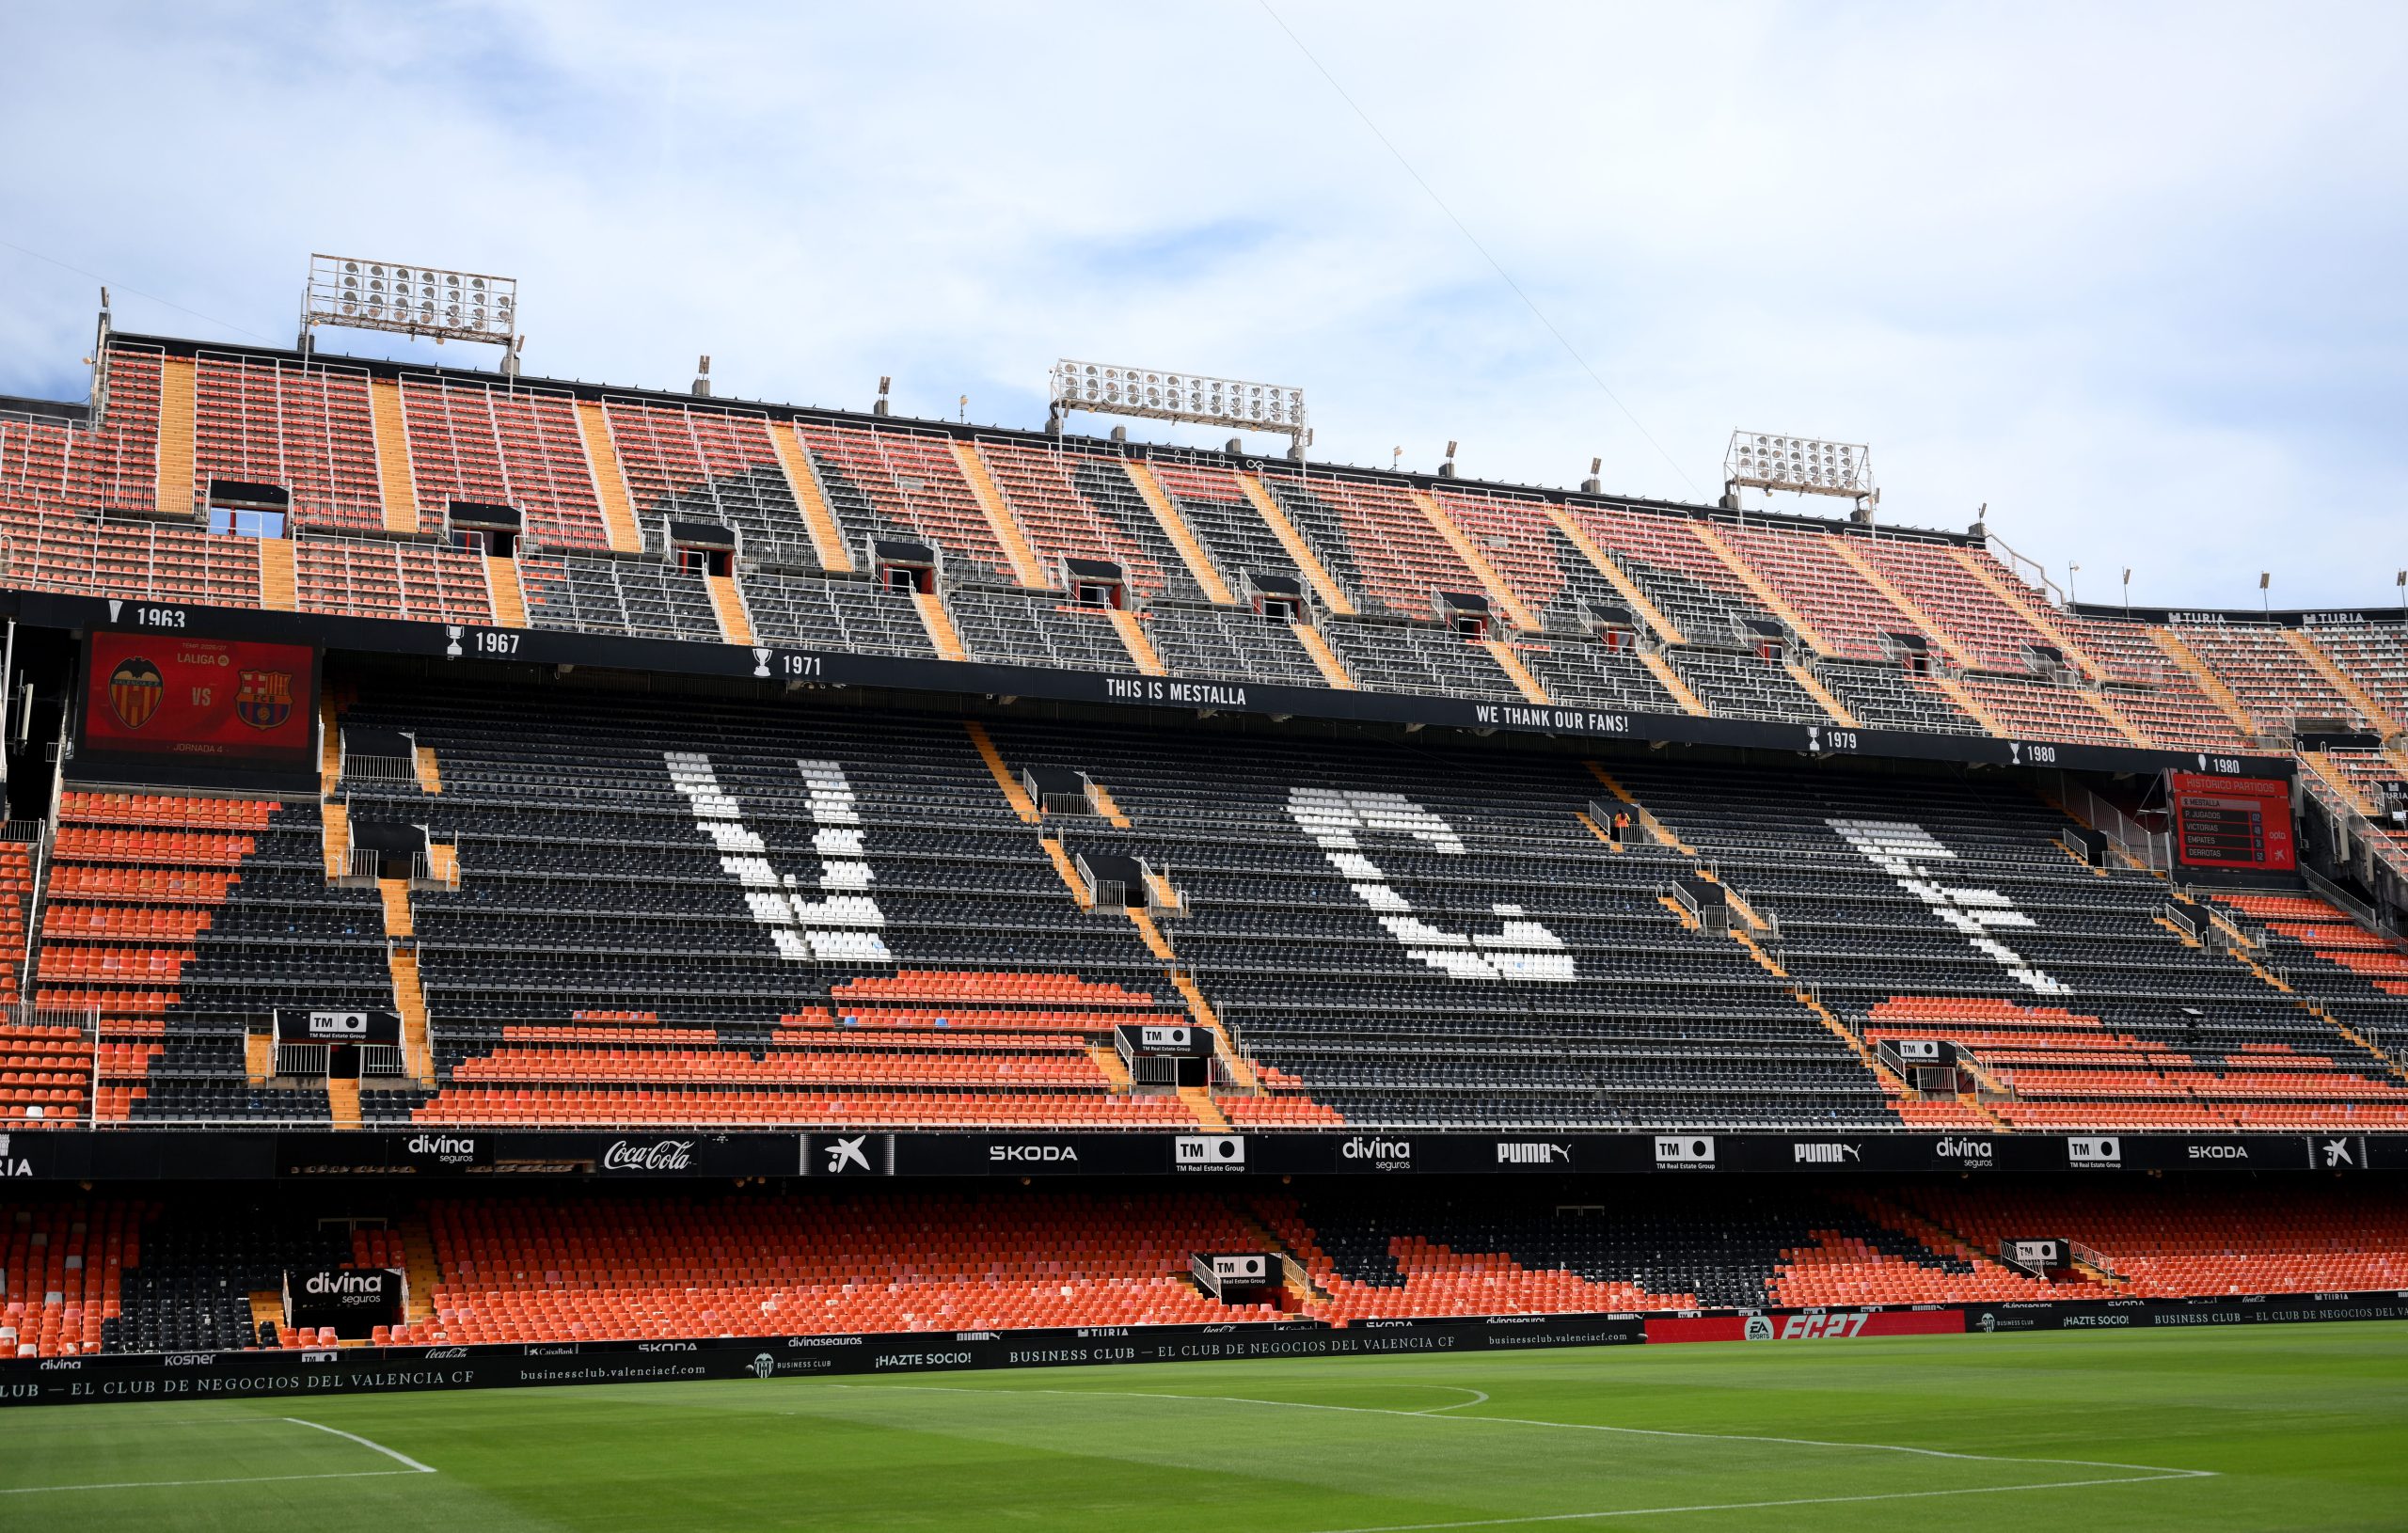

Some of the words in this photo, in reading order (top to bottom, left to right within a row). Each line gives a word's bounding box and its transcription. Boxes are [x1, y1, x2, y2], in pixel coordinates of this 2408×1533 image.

[137, 608, 185, 627] 1963
[2183, 613, 2226, 624] TURIA
[2319, 613, 2365, 624] TURIA
[476, 632, 519, 654] 1967
[177, 653, 214, 664] LALIGA
[783, 656, 820, 675] 1971
[192, 687, 211, 705] VS
[1106, 679, 1142, 698] THIS
[1149, 682, 1163, 699] IS
[1170, 683, 1245, 704] MESTALLA
[1477, 705, 1498, 723] WE
[1503, 707, 1550, 727] THANK
[1555, 711, 1583, 729] OUR
[1588, 713, 1628, 733] FANS!
[1827, 731, 1857, 749] 1979
[173, 743, 214, 752] JORNADA
[2027, 746, 2055, 763] 1980
[2214, 758, 2240, 774] 1980
[2186, 778, 2231, 790] HISTÓRICO
[2234, 781, 2274, 792] PARTIDOS
[2190, 798, 2220, 807] MESTALLA
[2186, 823, 2218, 831] VICTORIAS
[2188, 836, 2215, 845] EMPATES
[2190, 848, 2221, 858] DERROTAS
[314, 1018, 332, 1028] TM
[1146, 1031, 1162, 1040] TM
[1903, 1045, 1915, 1053] TM
[408, 1134, 474, 1154] divina
[1180, 1144, 1203, 1157] TM
[1342, 1137, 1410, 1159] divina
[1659, 1143, 1679, 1156] TM
[1936, 1137, 1991, 1158] divina
[2072, 1143, 2090, 1156] TM
[439, 1155, 473, 1163] seguros
[604, 1140, 695, 1170] Coca-Cola
[1497, 1143, 1550, 1163] PUMA
[1795, 1144, 1843, 1162] PUMA
[1225, 1164, 1244, 1174] Group
[1375, 1161, 1410, 1171] seguros
[1964, 1159, 1992, 1168] seguros
[2020, 1247, 2033, 1256] TM
[1217, 1263, 1234, 1272] TM
[307, 1272, 382, 1293] divina
[342, 1295, 380, 1304] seguros
[2064, 1318, 2096, 1327] ¡HAZTE
[2099, 1316, 2129, 1324] SOCIO!
[2155, 1314, 2208, 1324] BUSINESS
[2212, 1313, 2241, 1322] CLUB
[2257, 1312, 2269, 1321] EL
[2273, 1311, 2299, 1320] CLUB
[2303, 1310, 2316, 1320] DE
[2320, 1308, 2372, 1318] NEGOCIOS
[2376, 1307, 2395, 1317] DEL
[1750, 1321, 1768, 1333] EA
[1489, 1333, 1627, 1345] businessclub.valenciacf.com
[1010, 1350, 1087, 1363] BUSINESS
[1094, 1348, 1134, 1359] CLUB
[1159, 1346, 1176, 1356] EL
[1181, 1345, 1220, 1355] CLUB
[1227, 1344, 1244, 1354] DE
[1251, 1341, 1325, 1353] NEGOCIOS
[1332, 1340, 1358, 1351] DEL
[1364, 1337, 1433, 1350] VALENCIA
[1438, 1336, 1455, 1347] CF
[40, 1359, 81, 1369] divina
[875, 1354, 923, 1368] ¡HAZTE
[927, 1352, 971, 1364] SOCIO!
[520, 1366, 705, 1380] businessclub.valenciacf.com
[71, 1383, 94, 1396] EL
[103, 1381, 155, 1394] CLUB
[164, 1380, 189, 1392] DE
[198, 1377, 299, 1391] NEGOCIOS
[308, 1376, 344, 1388] DEL
[352, 1372, 444, 1386] VALENCIA
[452, 1371, 474, 1383] CF
